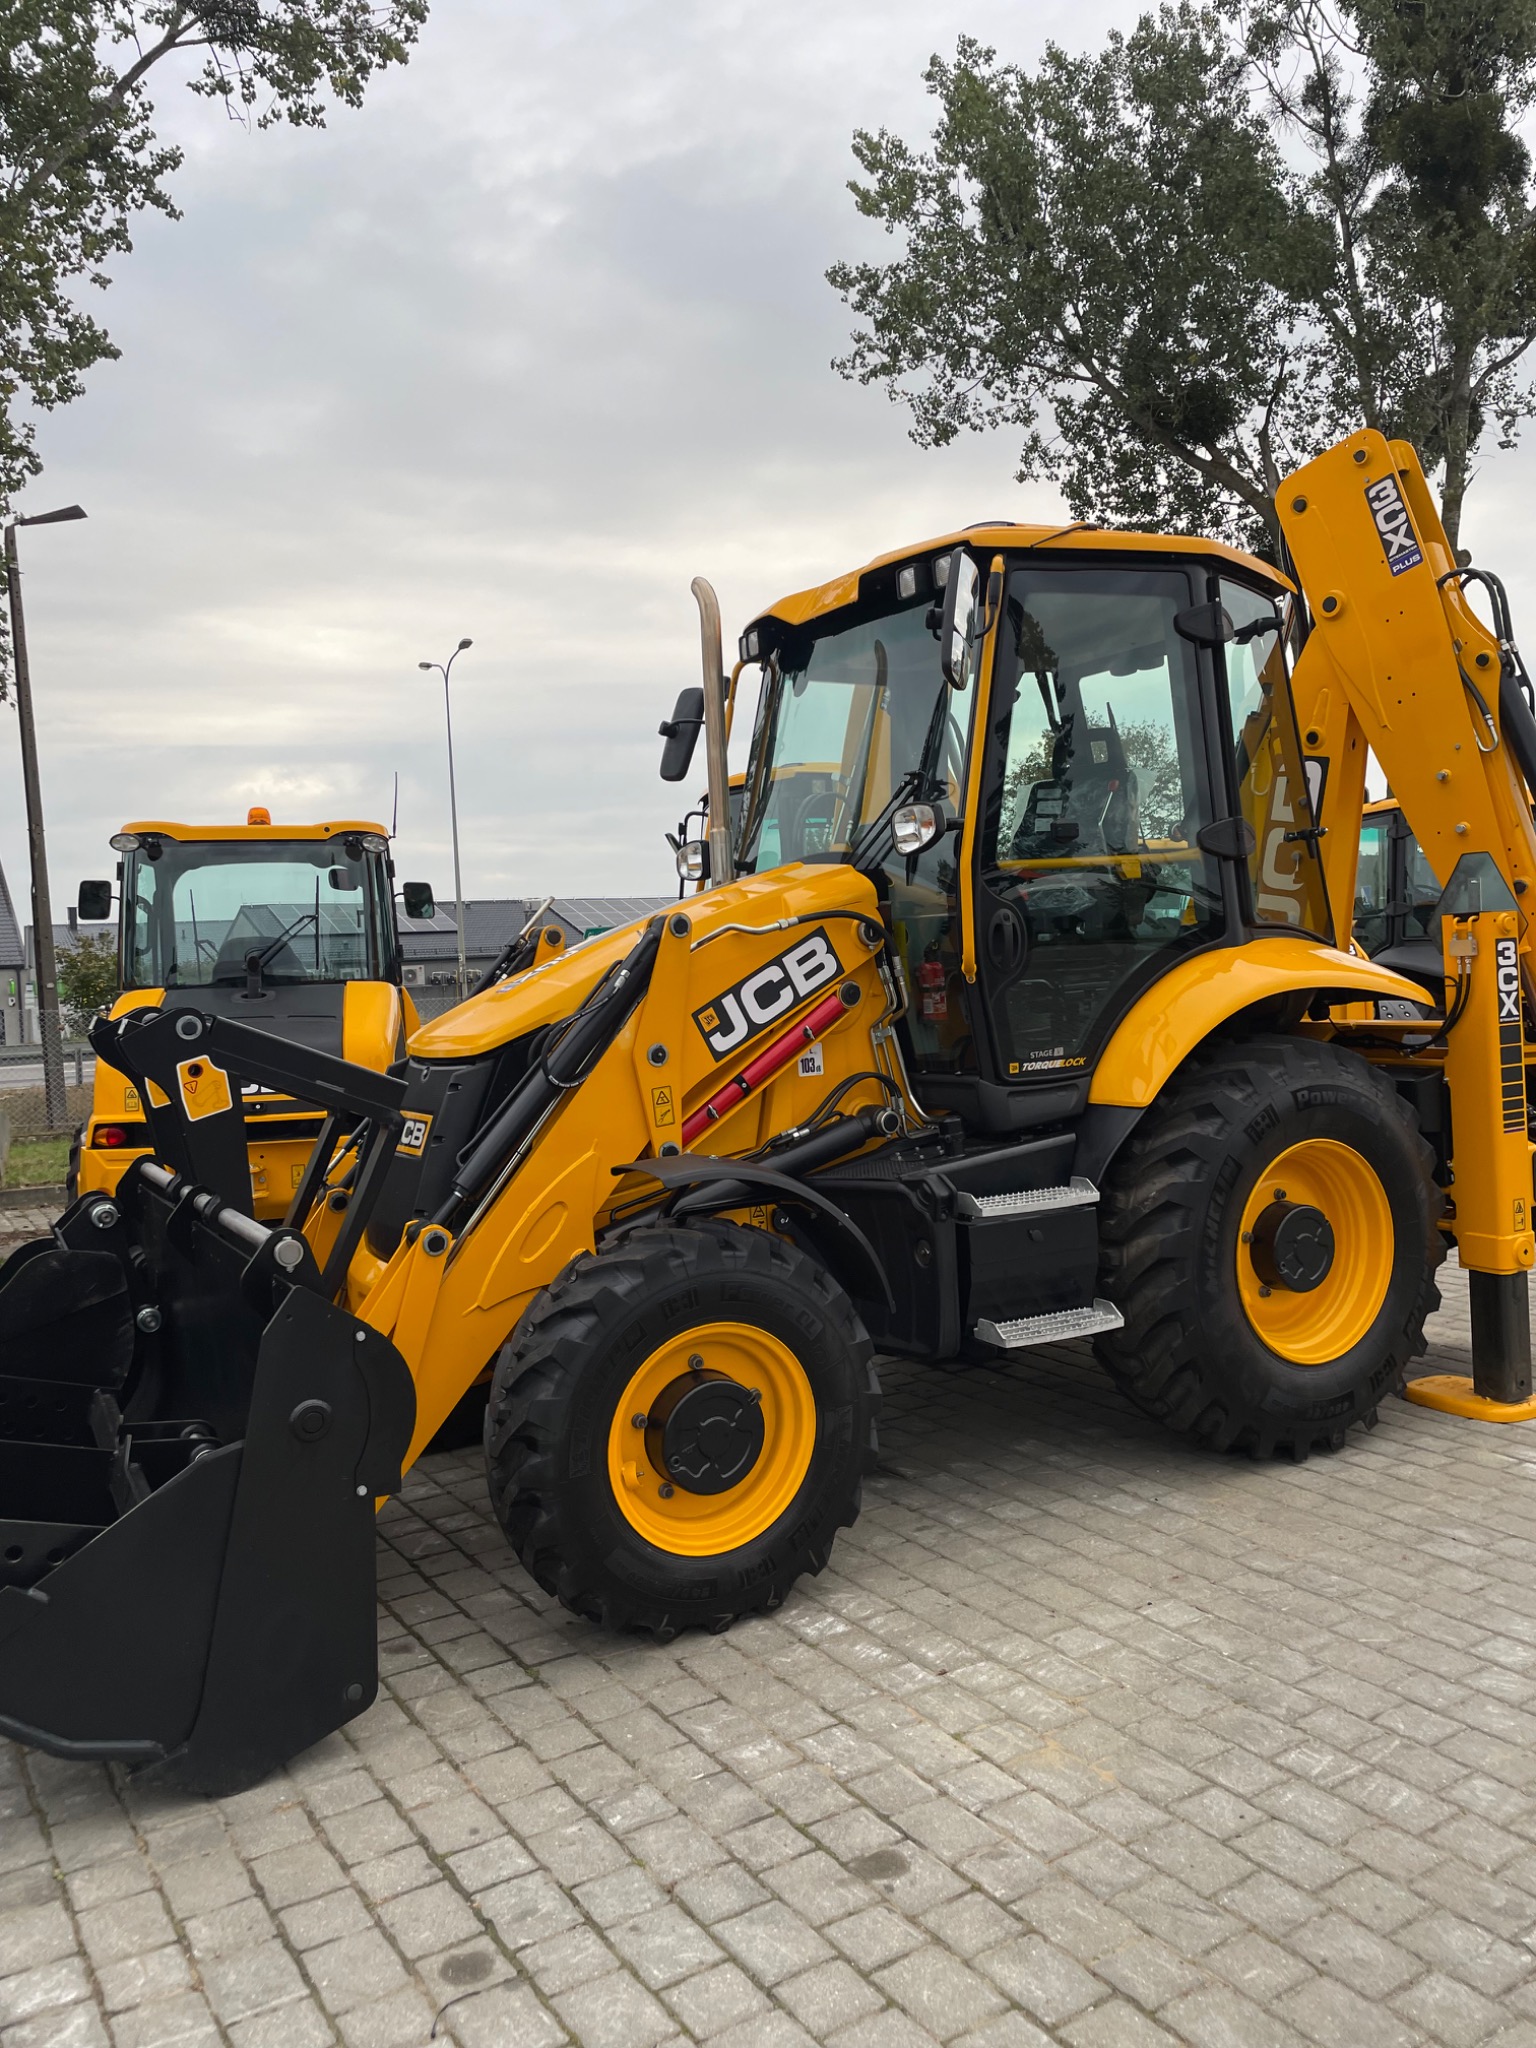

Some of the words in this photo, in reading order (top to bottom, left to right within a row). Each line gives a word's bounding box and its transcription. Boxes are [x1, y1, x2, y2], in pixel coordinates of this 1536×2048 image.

[1368, 478, 1416, 557] 3CX
[1392, 553, 1421, 573] PLUS
[1497, 941, 1519, 1017] 3CX
[709, 936, 837, 1053] JCB
[800, 1057, 815, 1073] 103
[1022, 1057, 1087, 1071] TORQUELOCK
[1030, 1048, 1053, 1059] STAGE
[401, 1120, 426, 1147] CB
